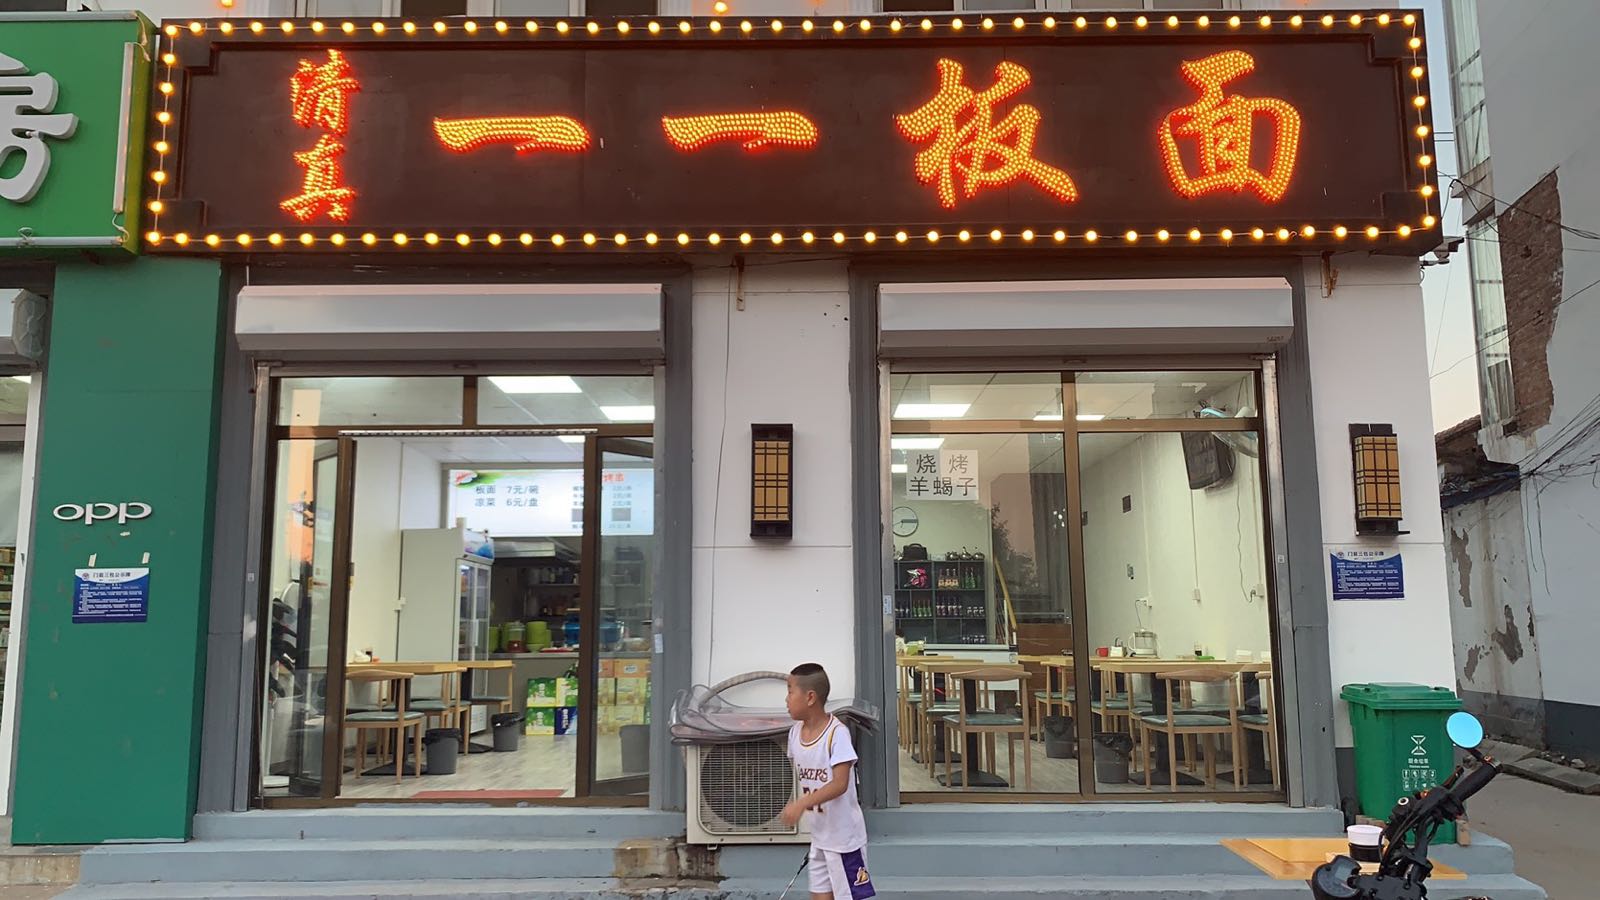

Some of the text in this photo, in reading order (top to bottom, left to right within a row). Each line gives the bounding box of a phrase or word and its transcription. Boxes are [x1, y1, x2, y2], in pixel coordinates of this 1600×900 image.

[280, 48, 361, 221] 清真
[433, 49, 1303, 209] 一一板面
[916, 453, 969, 474] 烧烤
[909, 476, 977, 497] 羊蝎子
[797, 764, 829, 782] AKERS
